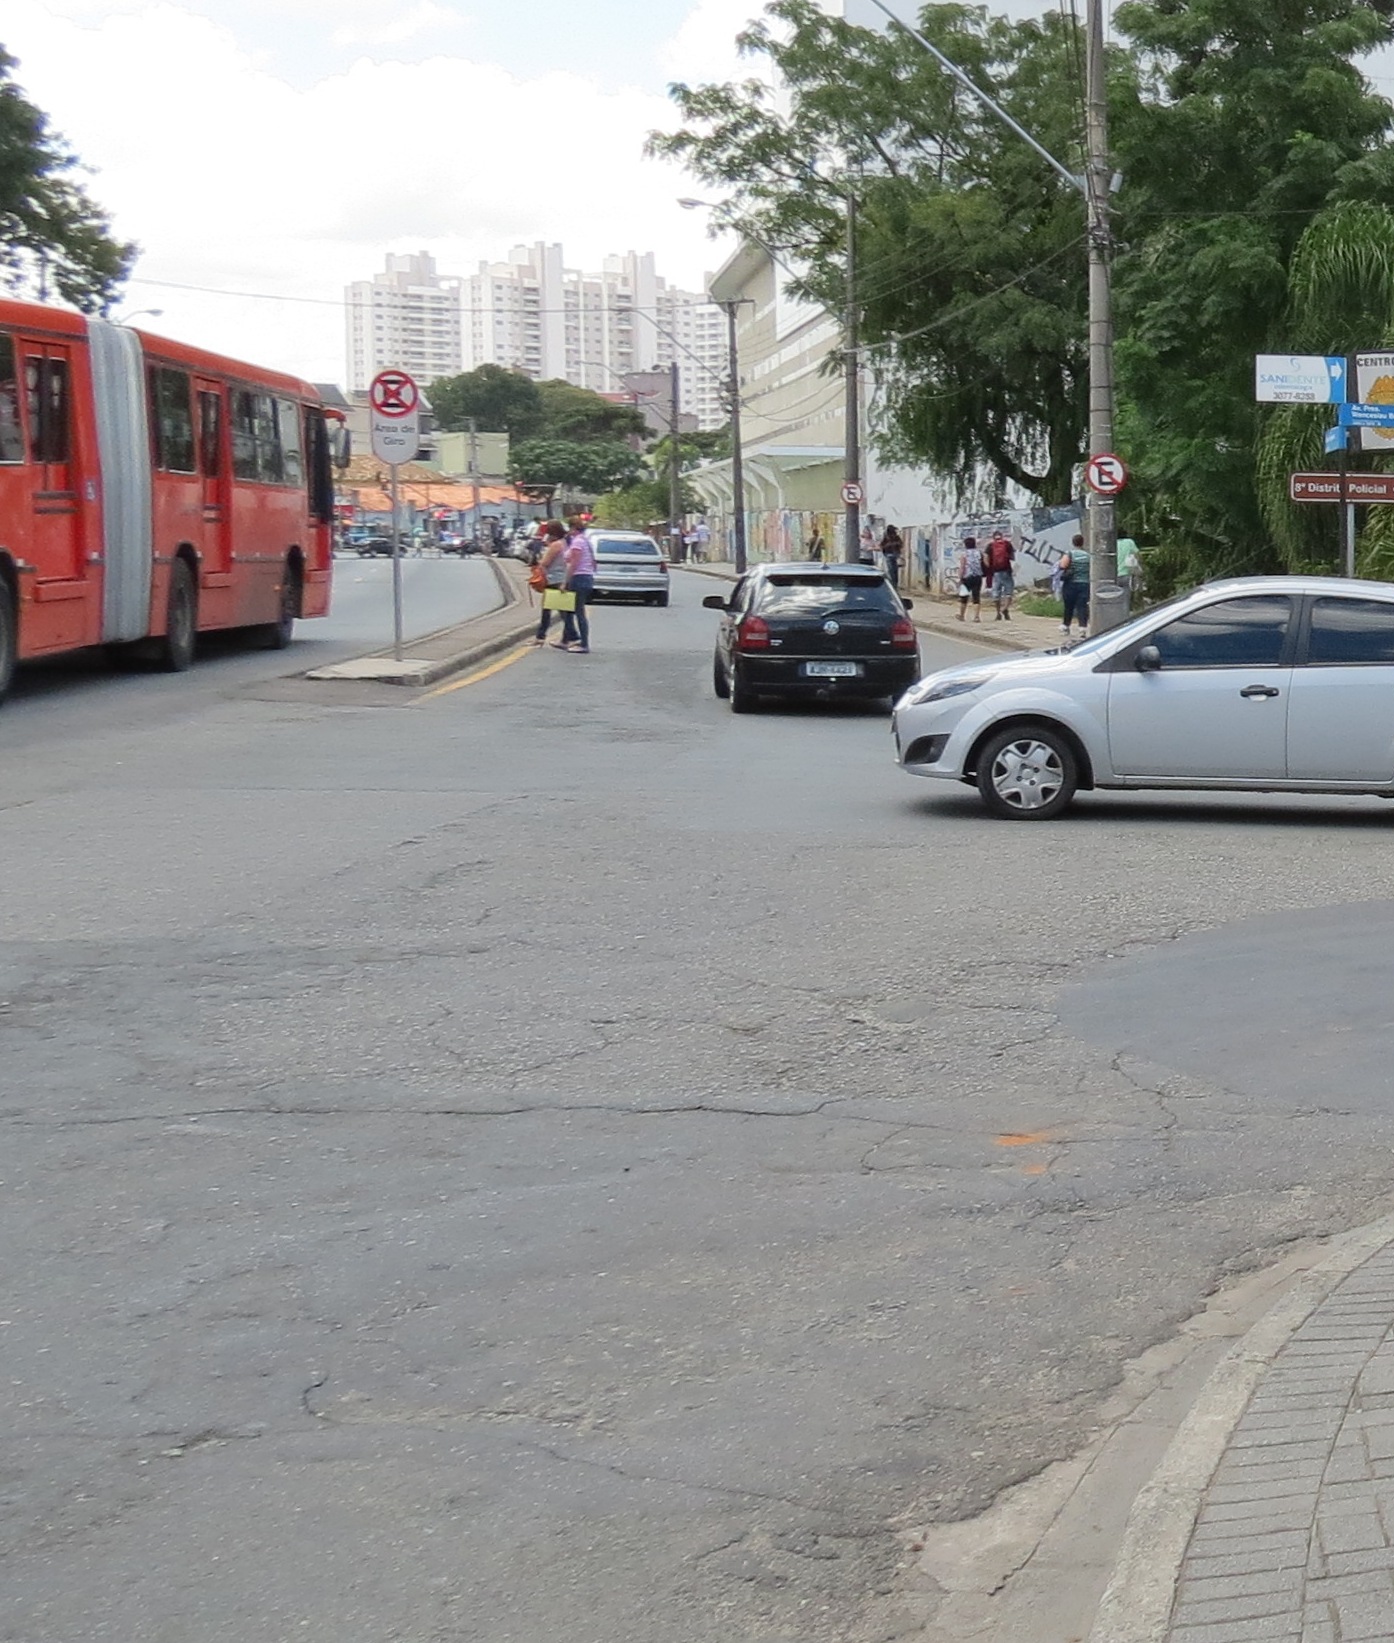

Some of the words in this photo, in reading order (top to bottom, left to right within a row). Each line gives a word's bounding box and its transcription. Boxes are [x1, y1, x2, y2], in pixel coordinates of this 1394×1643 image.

[1260, 374, 1327, 385] SANIDENTE
[1308, 482, 1342, 493] Distrit
[1348, 483, 1387, 494] Policial
